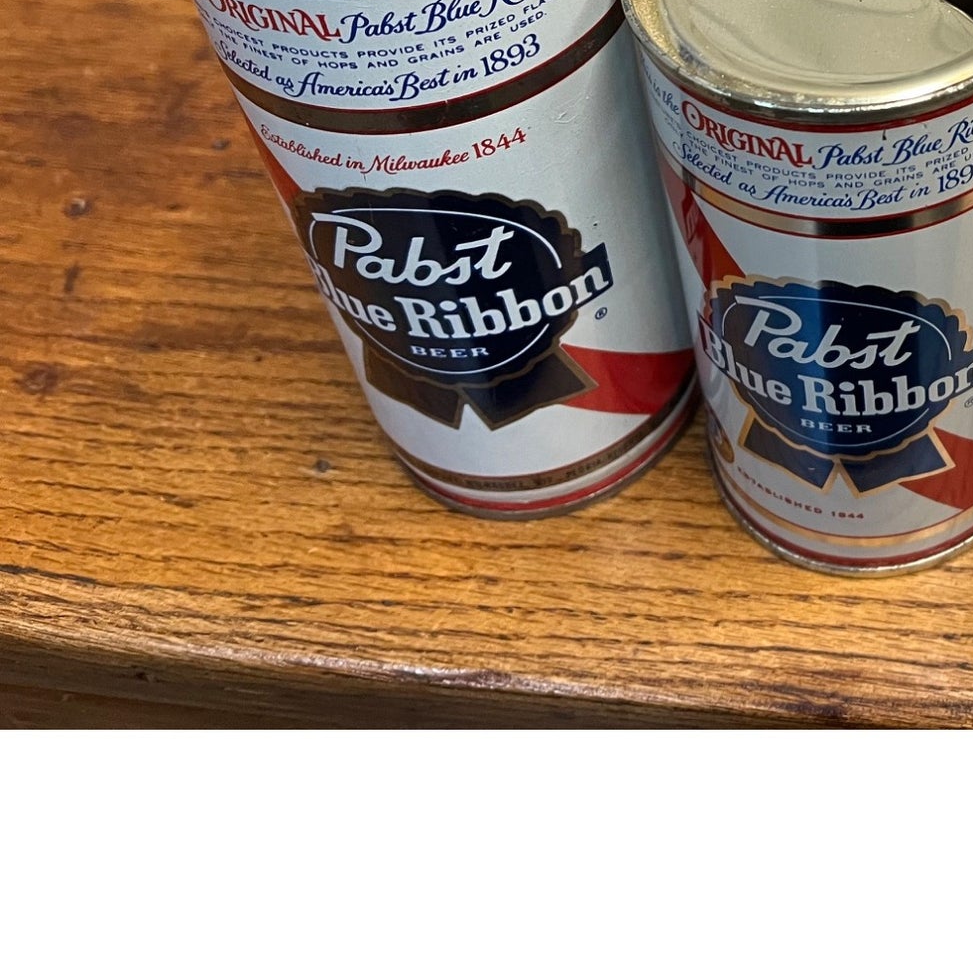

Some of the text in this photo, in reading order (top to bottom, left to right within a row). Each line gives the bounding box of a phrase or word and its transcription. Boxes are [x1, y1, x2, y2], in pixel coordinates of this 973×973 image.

[213, 18, 264, 46] CHOICEST
[272, 43, 349, 59] PRODUCTS
[357, 43, 425, 59] PROVIDE
[433, 36, 457, 48] ITS
[465, 13, 516, 39] PRIZED
[219, 11, 548, 69] THE FINEST OF HOPS AND GRAINS ARE USED.
[338, 11, 417, 43] Pabst
[214, 33, 541, 102] Selected as America's Best in 1893
[259, 123, 528, 175] Established in Milwaukee 1844
[661, 89, 681, 117] the
[681, 100, 813, 168] ORIGINAL
[811, 142, 884, 171] Pabst
[882, 134, 943, 166] Blue
[686, 130, 739, 162] CHOICEST
[746, 160, 817, 180] PRODUCTS
[826, 170, 887, 181] PROVIDE
[895, 164, 917, 174] ITS
[925, 146, 969, 168] PRIZED
[672, 140, 732, 186] Selected
[738, 181, 756, 197] as
[751, 185, 853, 208] America's
[849, 188, 905, 210] Best
[909, 182, 931, 200] in
[689, 139, 709, 157] THE
[714, 155, 754, 176] FINEST
[762, 173, 779, 182] OF
[788, 178, 825, 189] HOPS
[834, 180, 865, 188] AND
[873, 171, 924, 187] GRAINS
[932, 159, 957, 174] ARE
[310, 211, 515, 287] Pabst
[394, 264, 612, 340] Ribbon
[410, 343, 490, 359] BEER
[734, 295, 921, 370] Pabst
[704, 330, 793, 406] Blue
[801, 418, 873, 434] BEER
[830, 510, 865, 520] 1844
